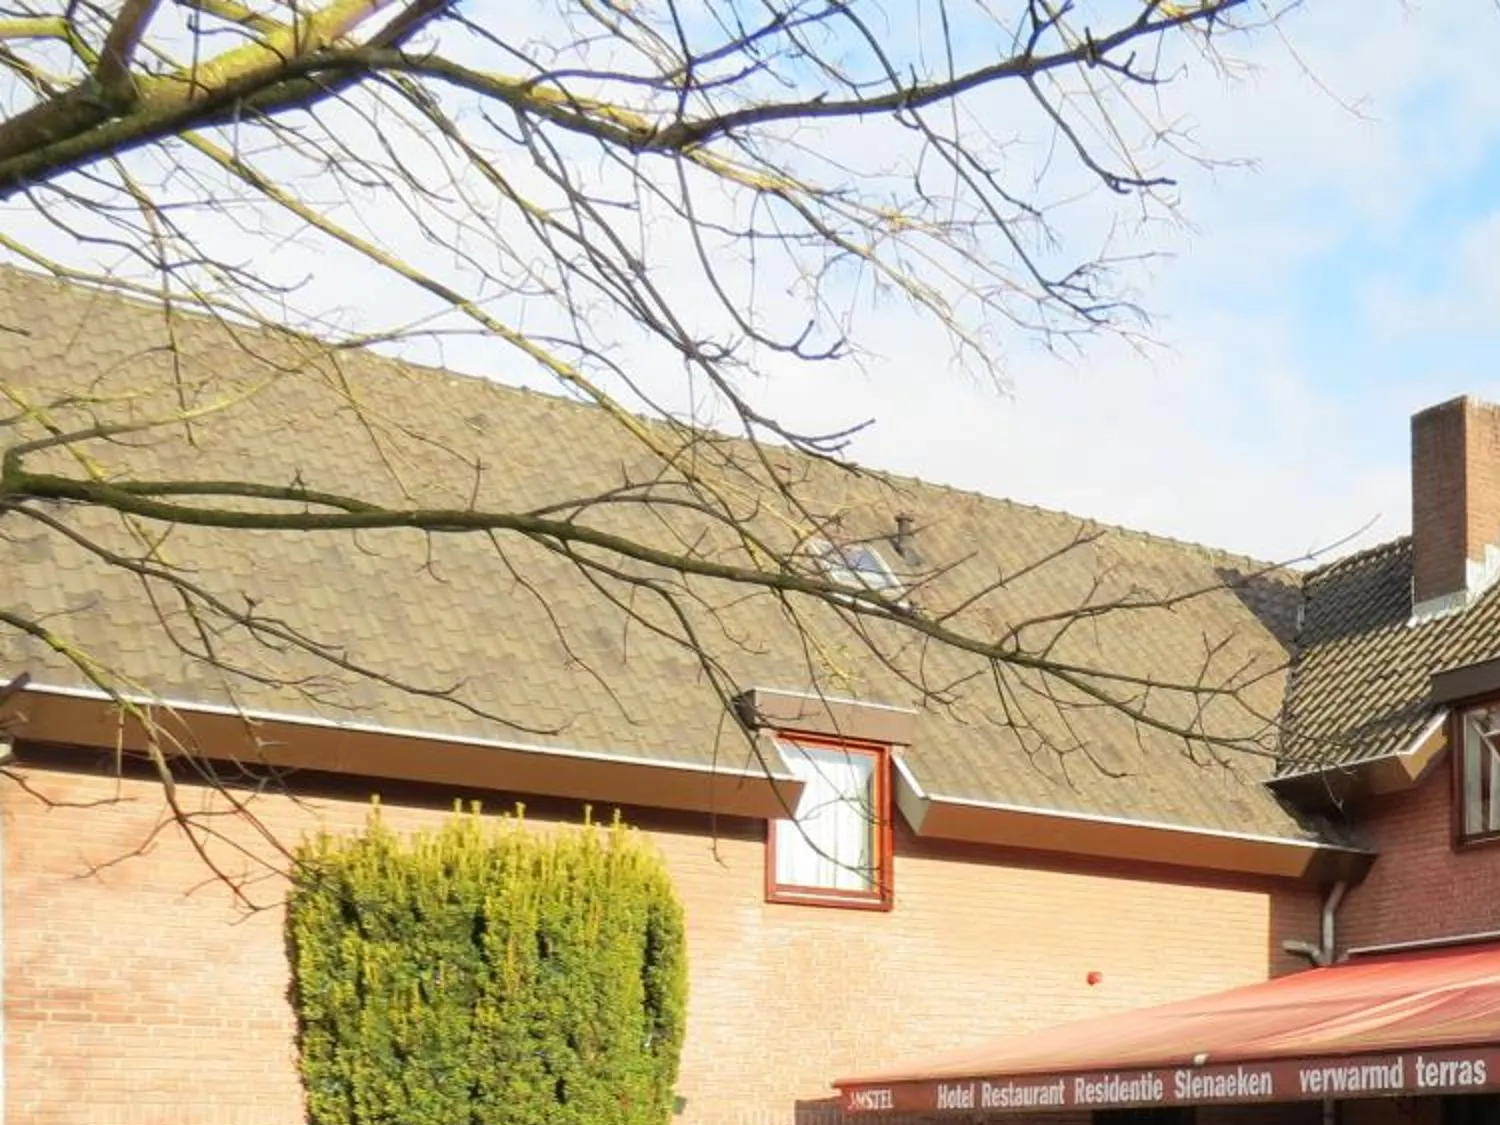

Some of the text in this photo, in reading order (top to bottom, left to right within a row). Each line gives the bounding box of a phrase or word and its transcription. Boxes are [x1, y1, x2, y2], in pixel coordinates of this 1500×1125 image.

[937, 1055, 1487, 1109] Hotel Restaurant Residentie Slenaeken verwarmd terras
